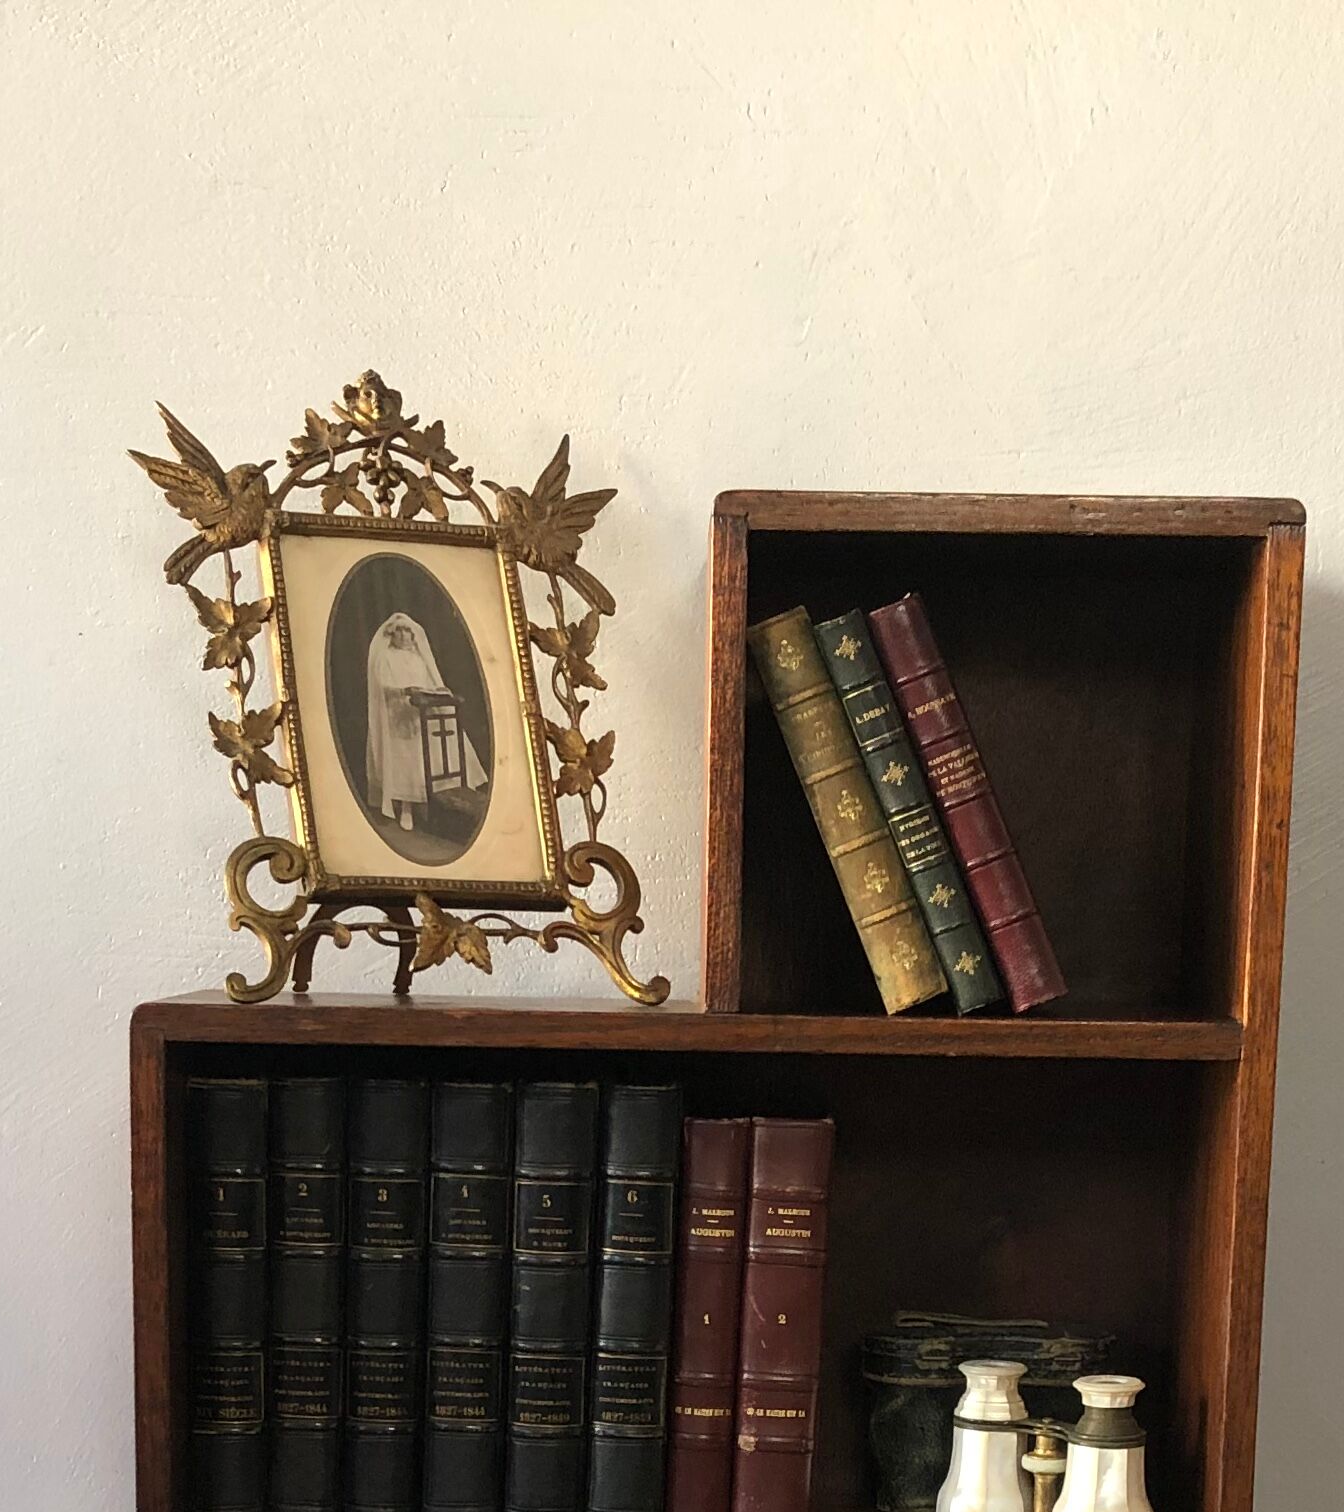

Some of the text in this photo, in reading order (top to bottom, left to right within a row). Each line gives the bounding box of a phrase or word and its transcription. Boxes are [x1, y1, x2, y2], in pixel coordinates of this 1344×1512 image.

[296, 1182, 309, 1197] 2
[376, 1188, 390, 1203] 3
[541, 1194, 553, 1208] 5
[626, 1189, 639, 1204] 6
[690, 1227, 735, 1238] AUGUSTIN
[765, 1227, 812, 1238] AUGUSTIN
[703, 1313, 710, 1325] 1
[777, 1313, 786, 1325] 2
